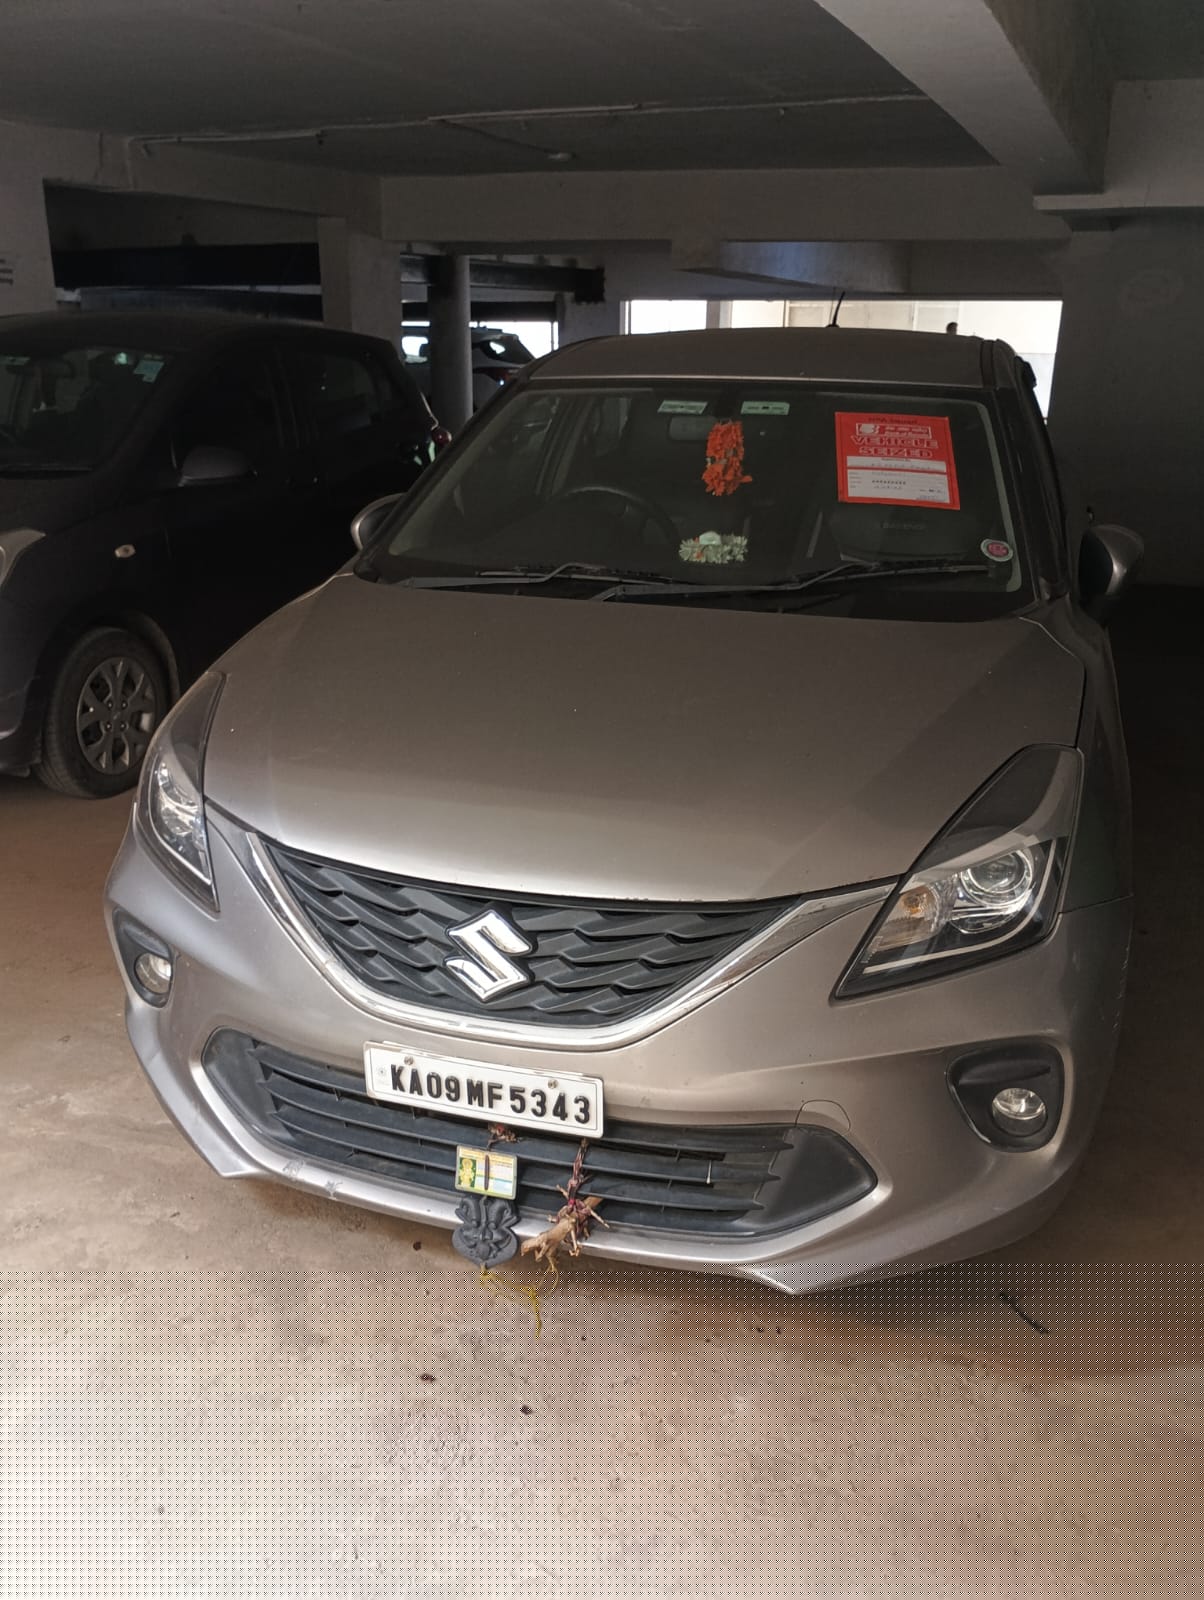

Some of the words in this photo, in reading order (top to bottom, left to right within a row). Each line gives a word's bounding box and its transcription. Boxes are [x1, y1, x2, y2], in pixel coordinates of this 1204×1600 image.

[850, 434, 939, 449] VEHICLE
[859, 446, 933, 458] SEIZED
[390, 1063, 590, 1125] KA09MF5343
